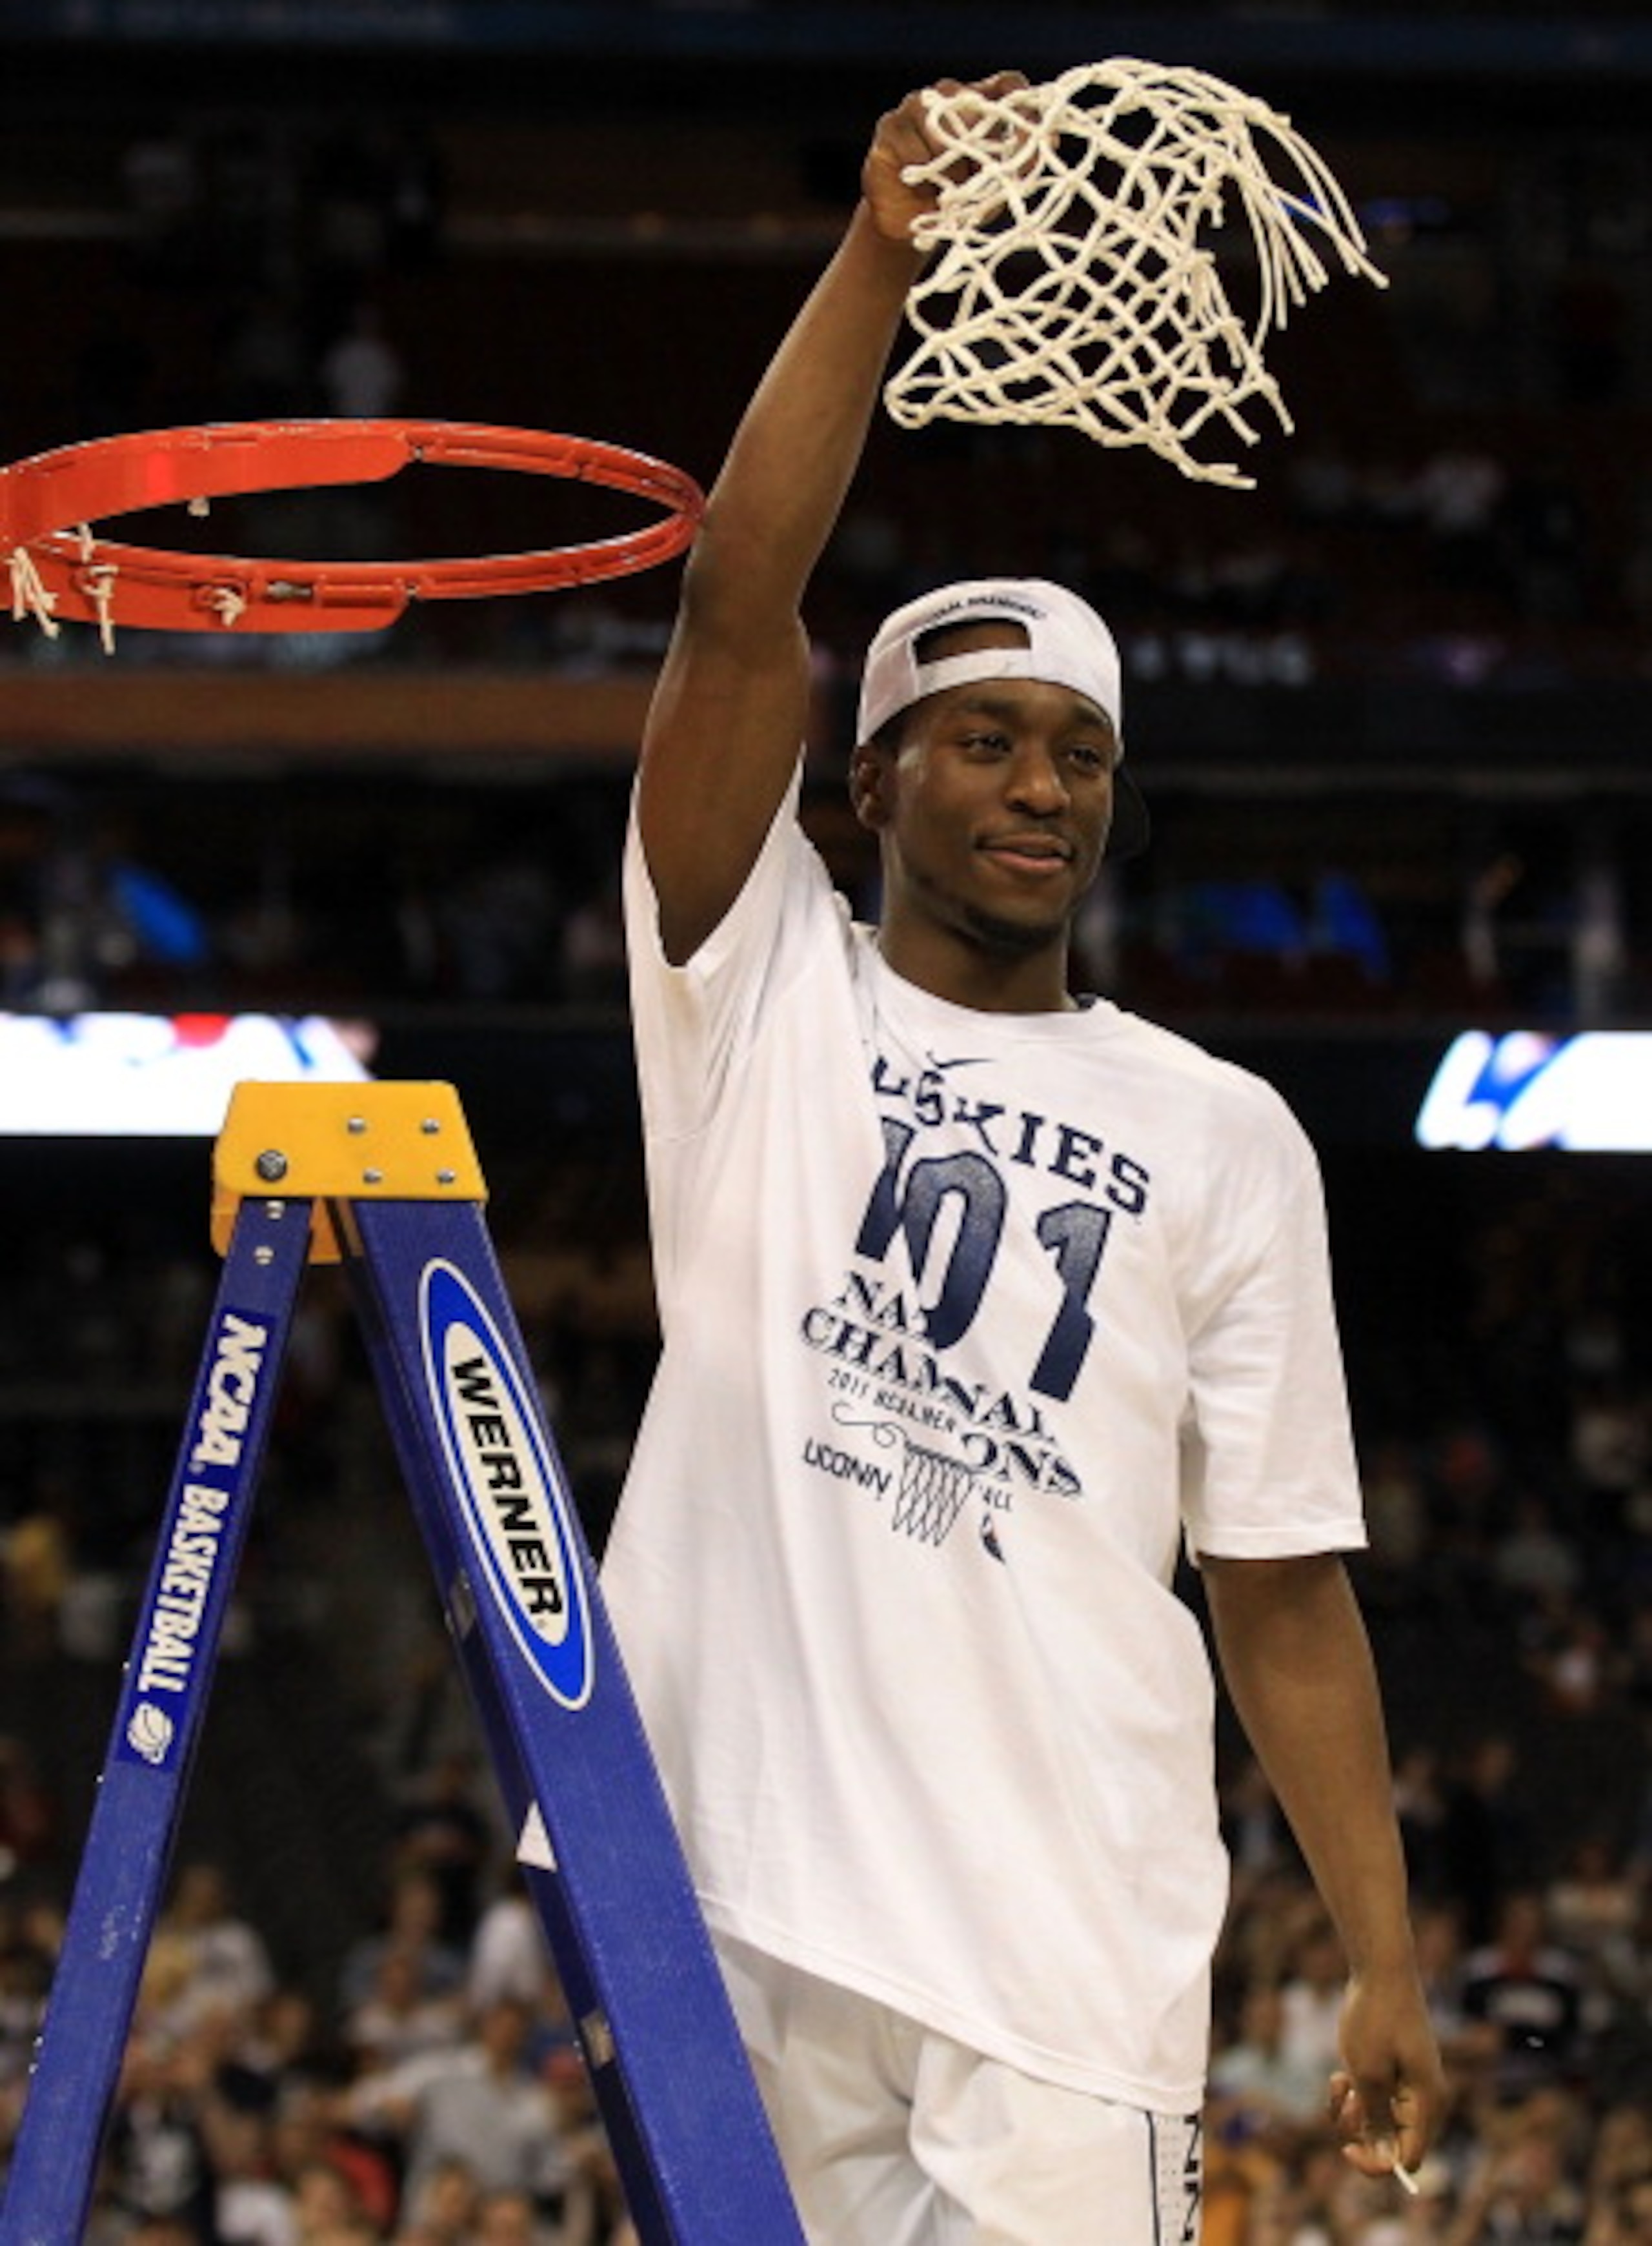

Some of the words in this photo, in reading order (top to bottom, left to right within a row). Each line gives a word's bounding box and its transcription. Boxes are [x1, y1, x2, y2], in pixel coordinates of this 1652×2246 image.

[194, 1313, 267, 1468] NCAA
[803, 1437, 892, 1495] UCONN
[450, 1355, 565, 1616] WERNER
[136, 1483, 230, 1694] BASKETBALL
